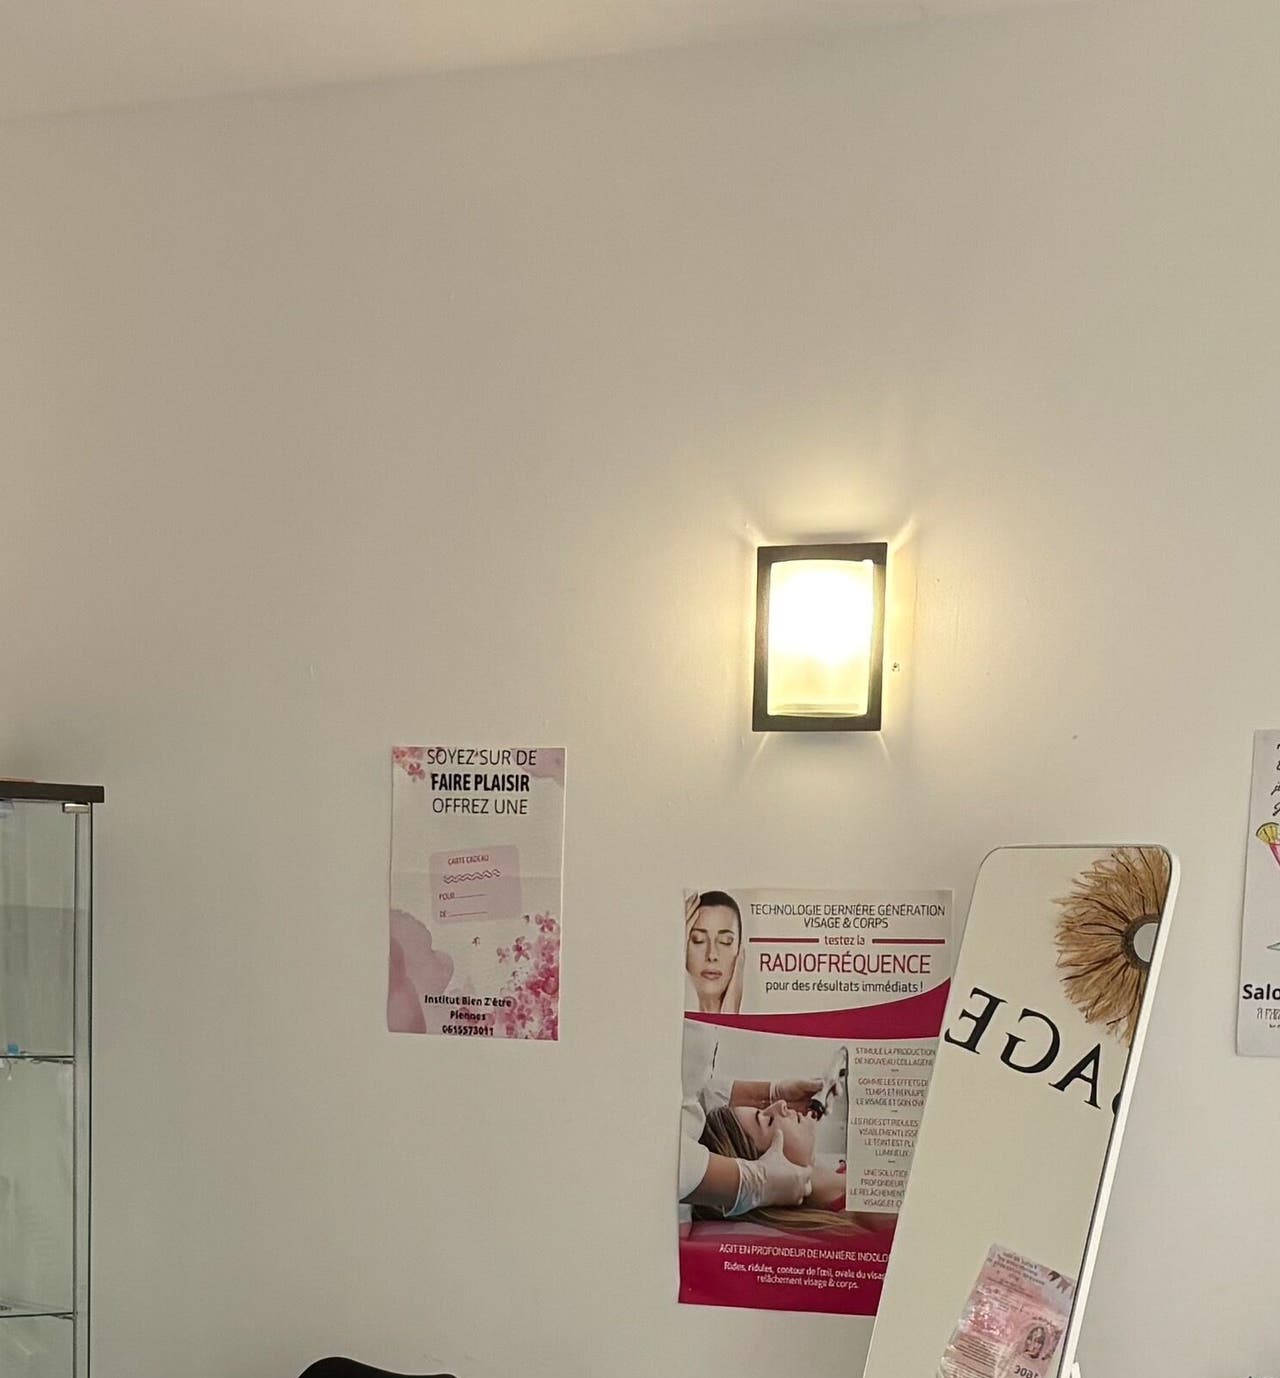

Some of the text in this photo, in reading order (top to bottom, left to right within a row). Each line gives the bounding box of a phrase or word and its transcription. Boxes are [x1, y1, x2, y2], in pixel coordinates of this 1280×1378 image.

[427, 748, 538, 766] SOYEZ SUR DE
[431, 773, 530, 792] FAIRE PLAISIR
[432, 797, 528, 815] OFFREZ UNE
[750, 903, 821, 917] TECHNOLOGIE
[877, 903, 946, 917] GÉNÉRATION
[803, 917, 889, 930] VISAGE & CORPS
[824, 934, 866, 947] testez la
[759, 951, 932, 976] RADIOFRÉQUENCE
[765, 982, 790, 993] pour
[792, 980, 810, 992] des
[812, 980, 860, 993] résultats
[862, 981, 919, 994] immédiats
[424, 994, 512, 1007] Institut Bien Z'être
[450, 1009, 486, 1021] Piennes
[751, 1245, 806, 1258] PROFONDEUR
